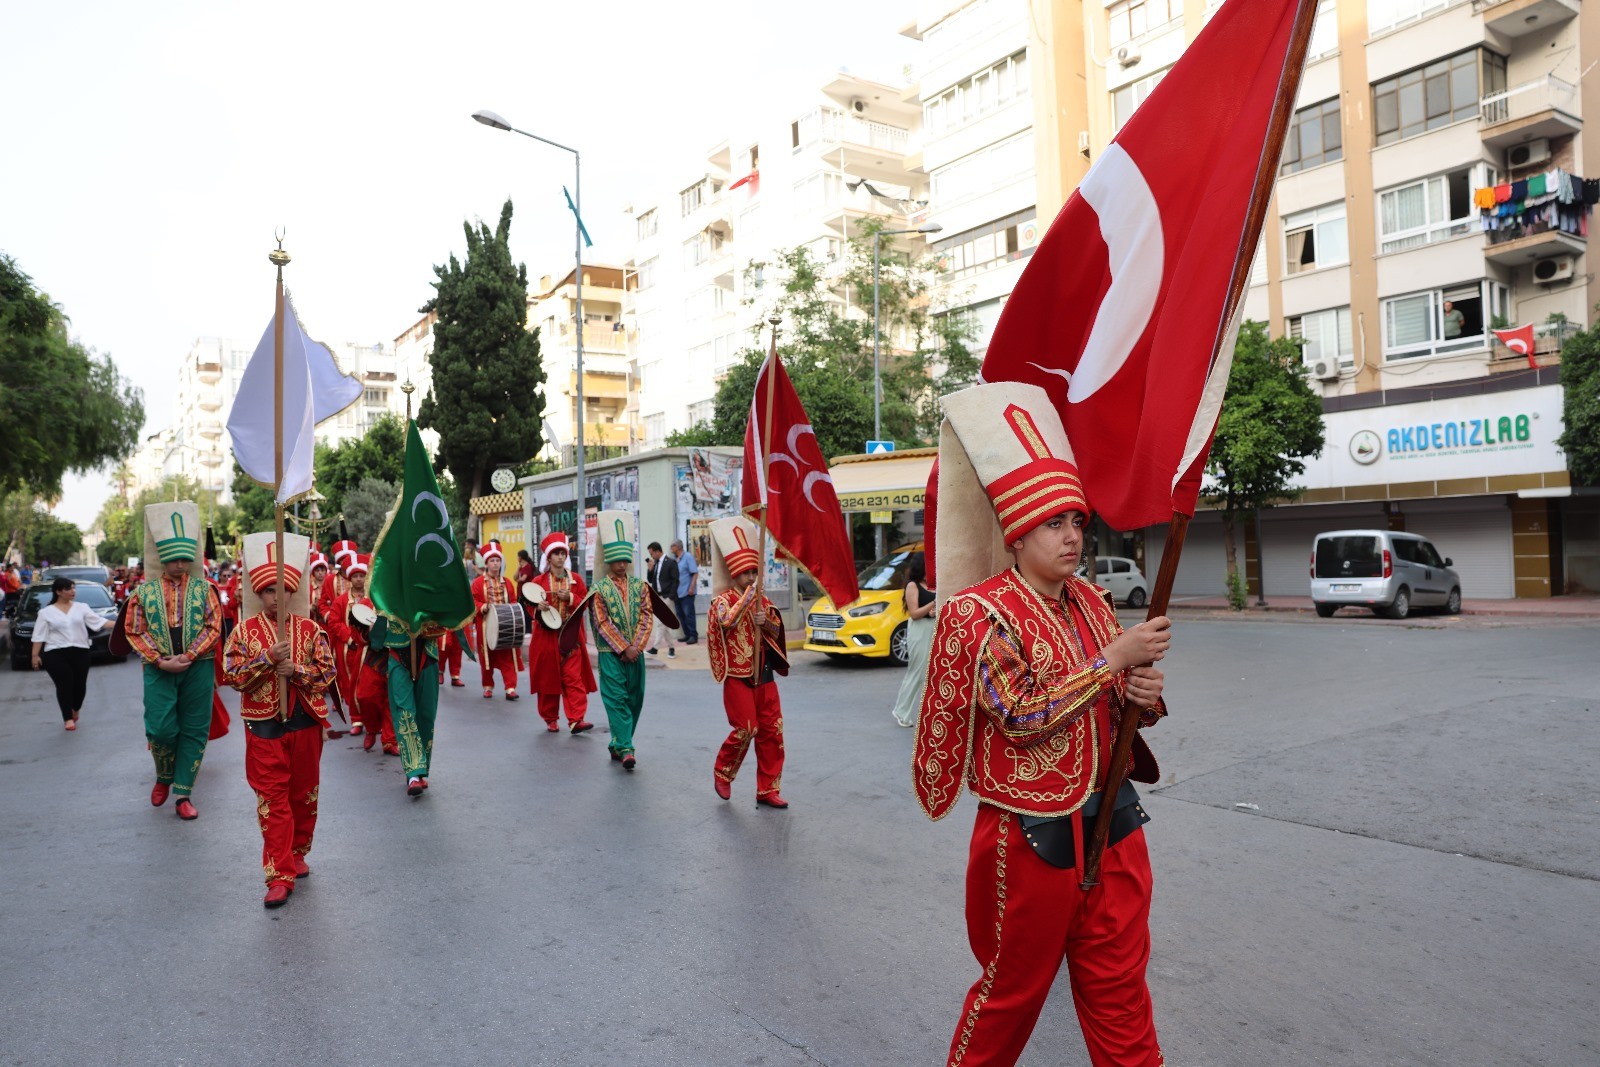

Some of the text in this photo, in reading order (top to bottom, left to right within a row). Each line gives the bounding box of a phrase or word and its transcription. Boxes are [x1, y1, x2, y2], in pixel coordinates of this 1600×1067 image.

[838, 498, 865, 508] 324
[866, 496, 889, 506] 231
[893, 495, 910, 504] 40
